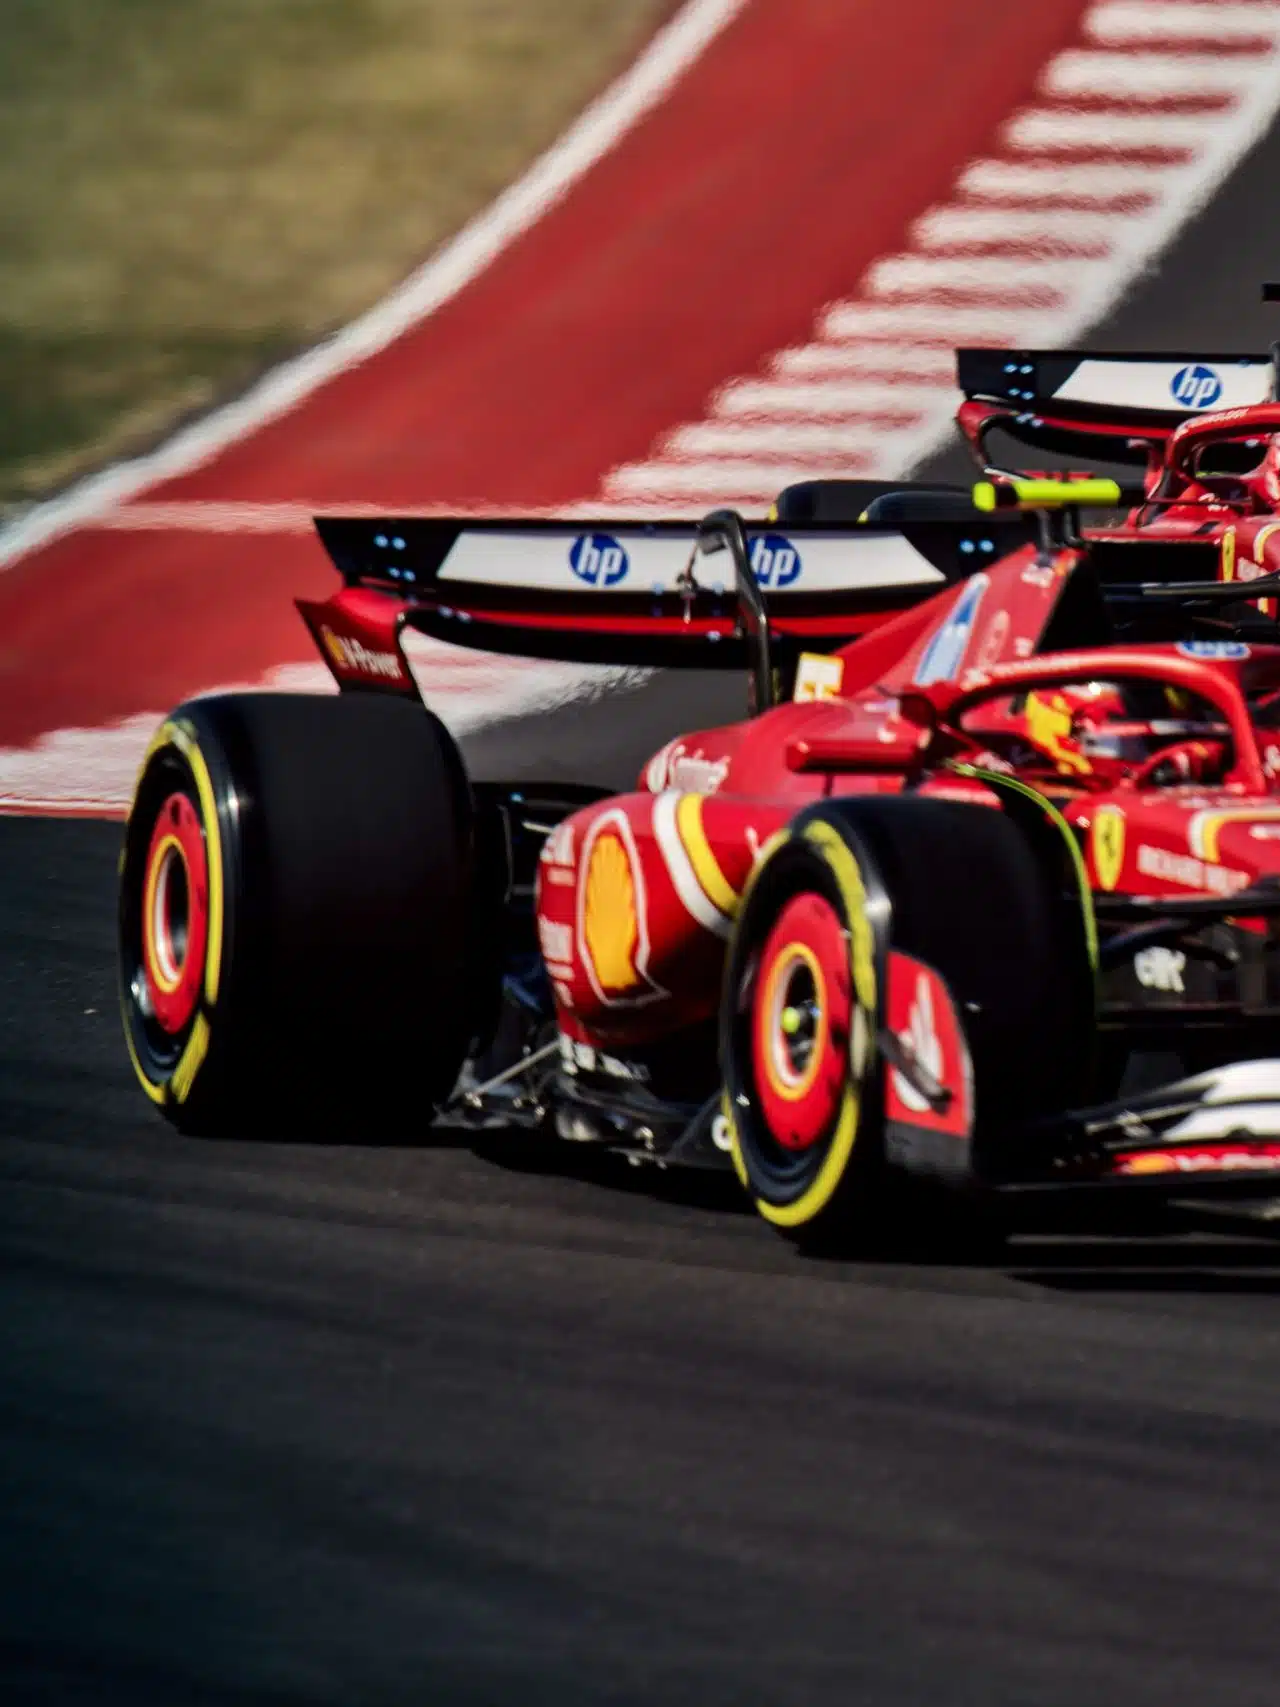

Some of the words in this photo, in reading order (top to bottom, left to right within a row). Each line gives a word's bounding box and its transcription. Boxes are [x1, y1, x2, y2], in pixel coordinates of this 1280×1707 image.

[1175, 365, 1218, 408] hp
[575, 534, 625, 587] hp
[750, 535, 797, 587] hp
